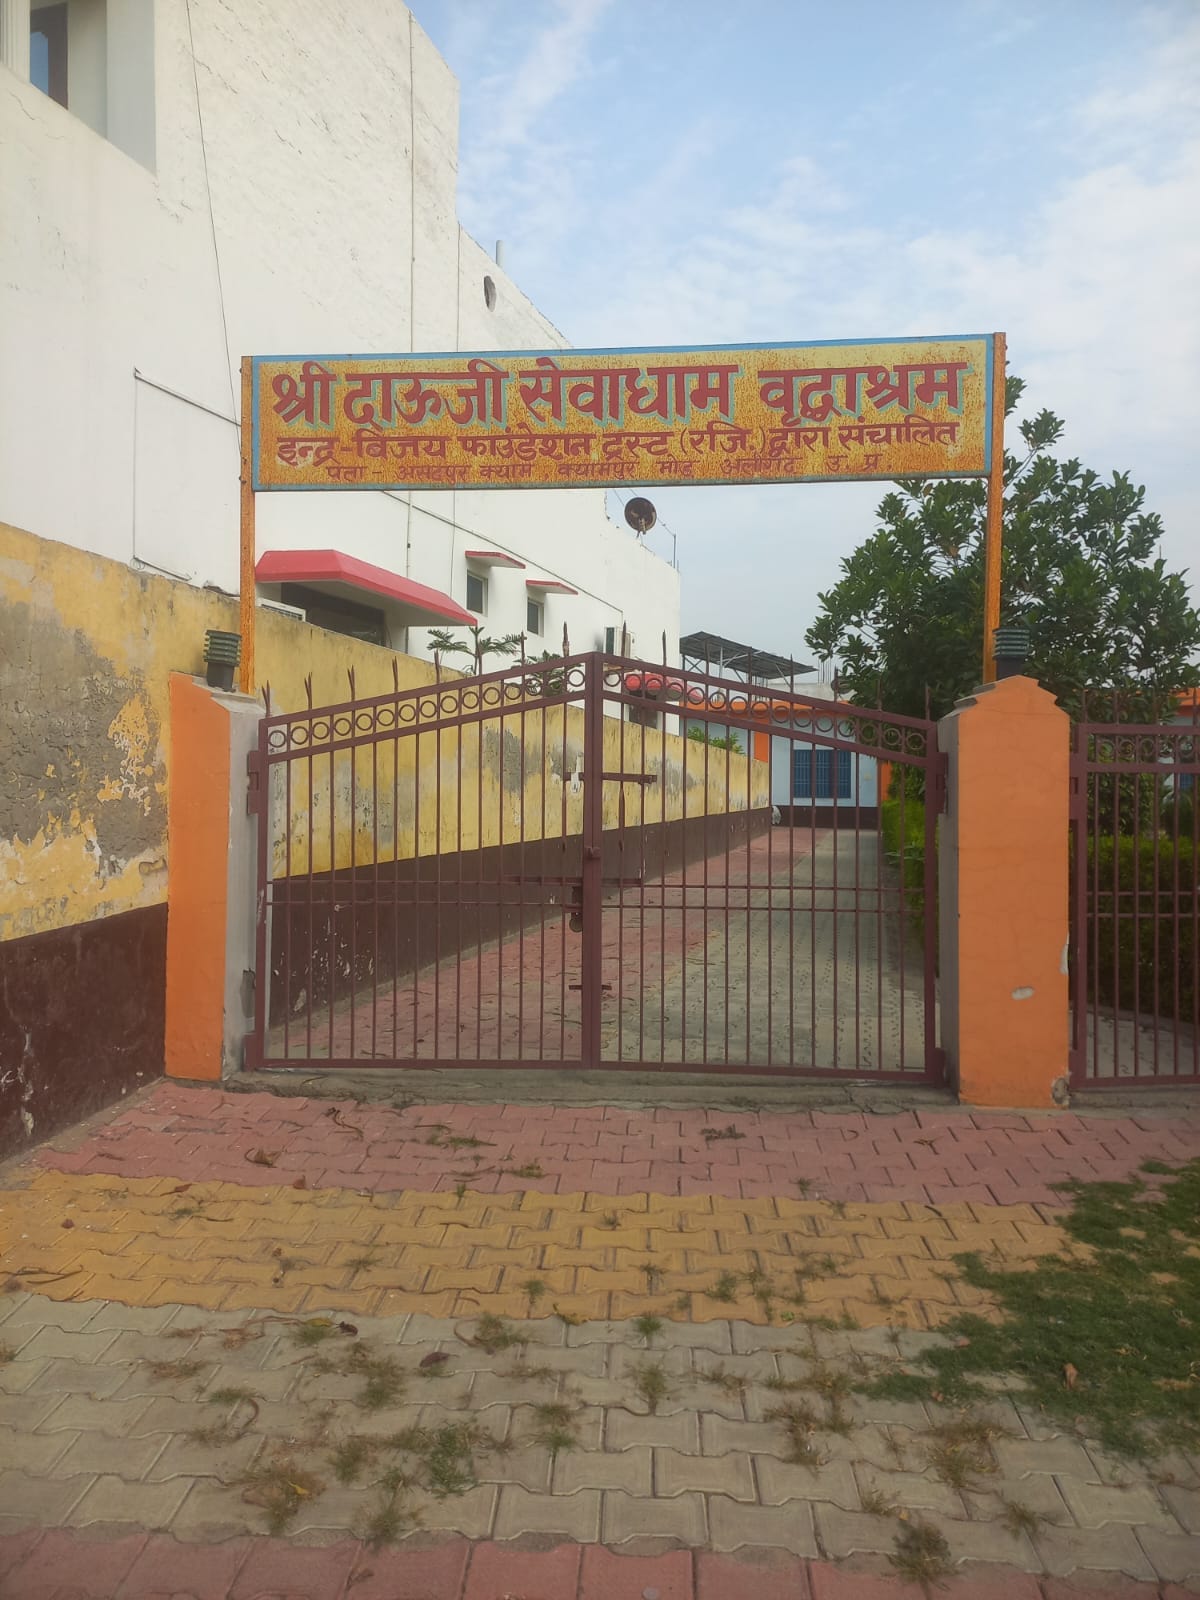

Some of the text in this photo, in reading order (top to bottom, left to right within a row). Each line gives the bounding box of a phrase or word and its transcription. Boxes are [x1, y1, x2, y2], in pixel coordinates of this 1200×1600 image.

[271, 360, 338, 428] श्री
[343, 358, 512, 432] दाऊजी
[518, 356, 741, 425] सेवाधाम
[837, 414, 961, 452] संचालित
